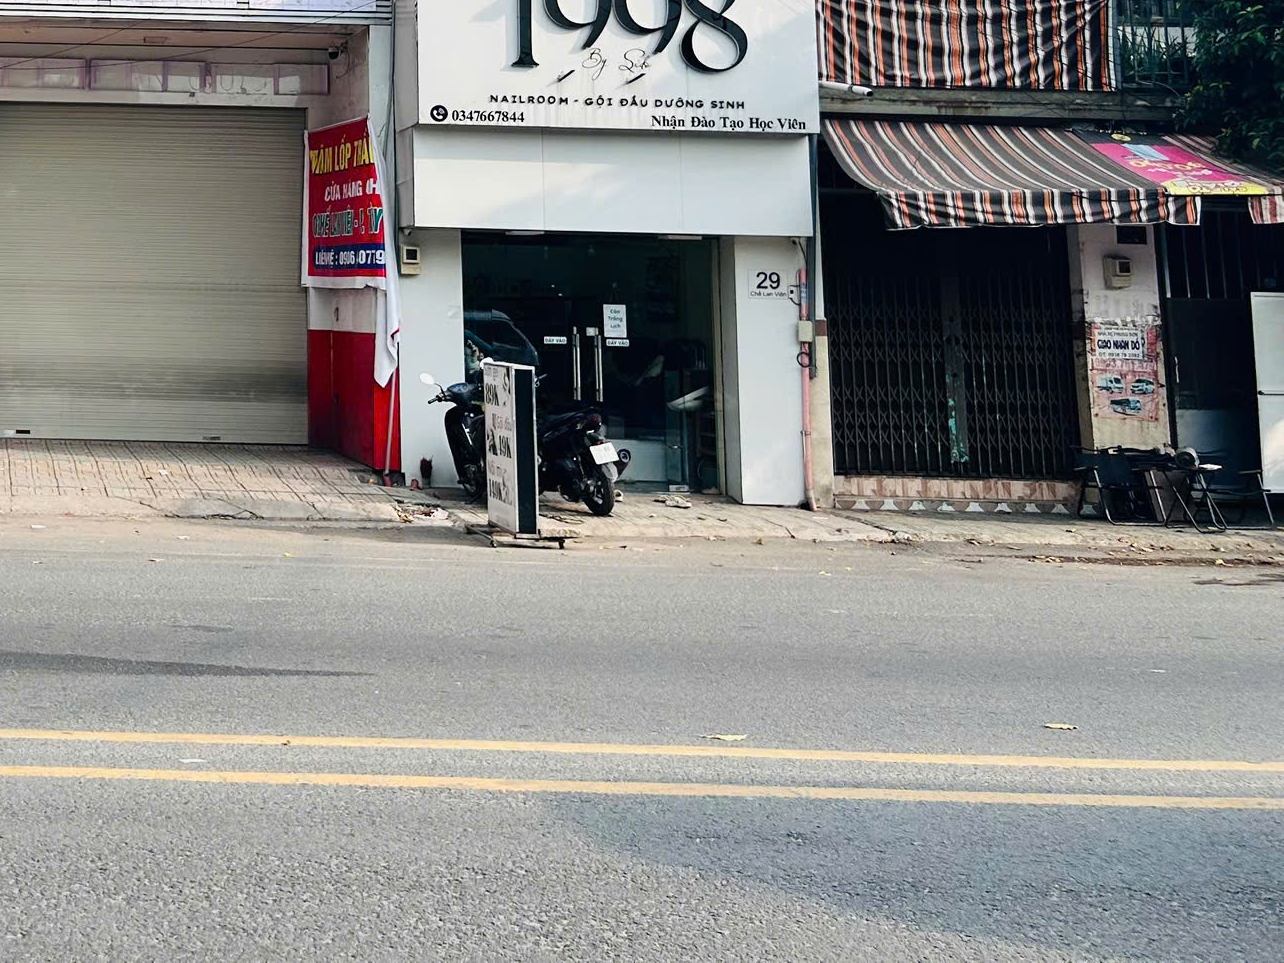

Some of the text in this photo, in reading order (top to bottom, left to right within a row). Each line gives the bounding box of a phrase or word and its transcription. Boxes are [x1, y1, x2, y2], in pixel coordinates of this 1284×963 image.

[490, 94, 568, 105] NAILROOM
[711, 100, 745, 110] SINH
[451, 109, 525, 123] 0347667844
[651, 115, 806, 132] Nhận Đào Tạo Học Viên
[334, 134, 352, 171] LỐP
[324, 181, 341, 202] CỬA
[756, 271, 781, 290] 29
